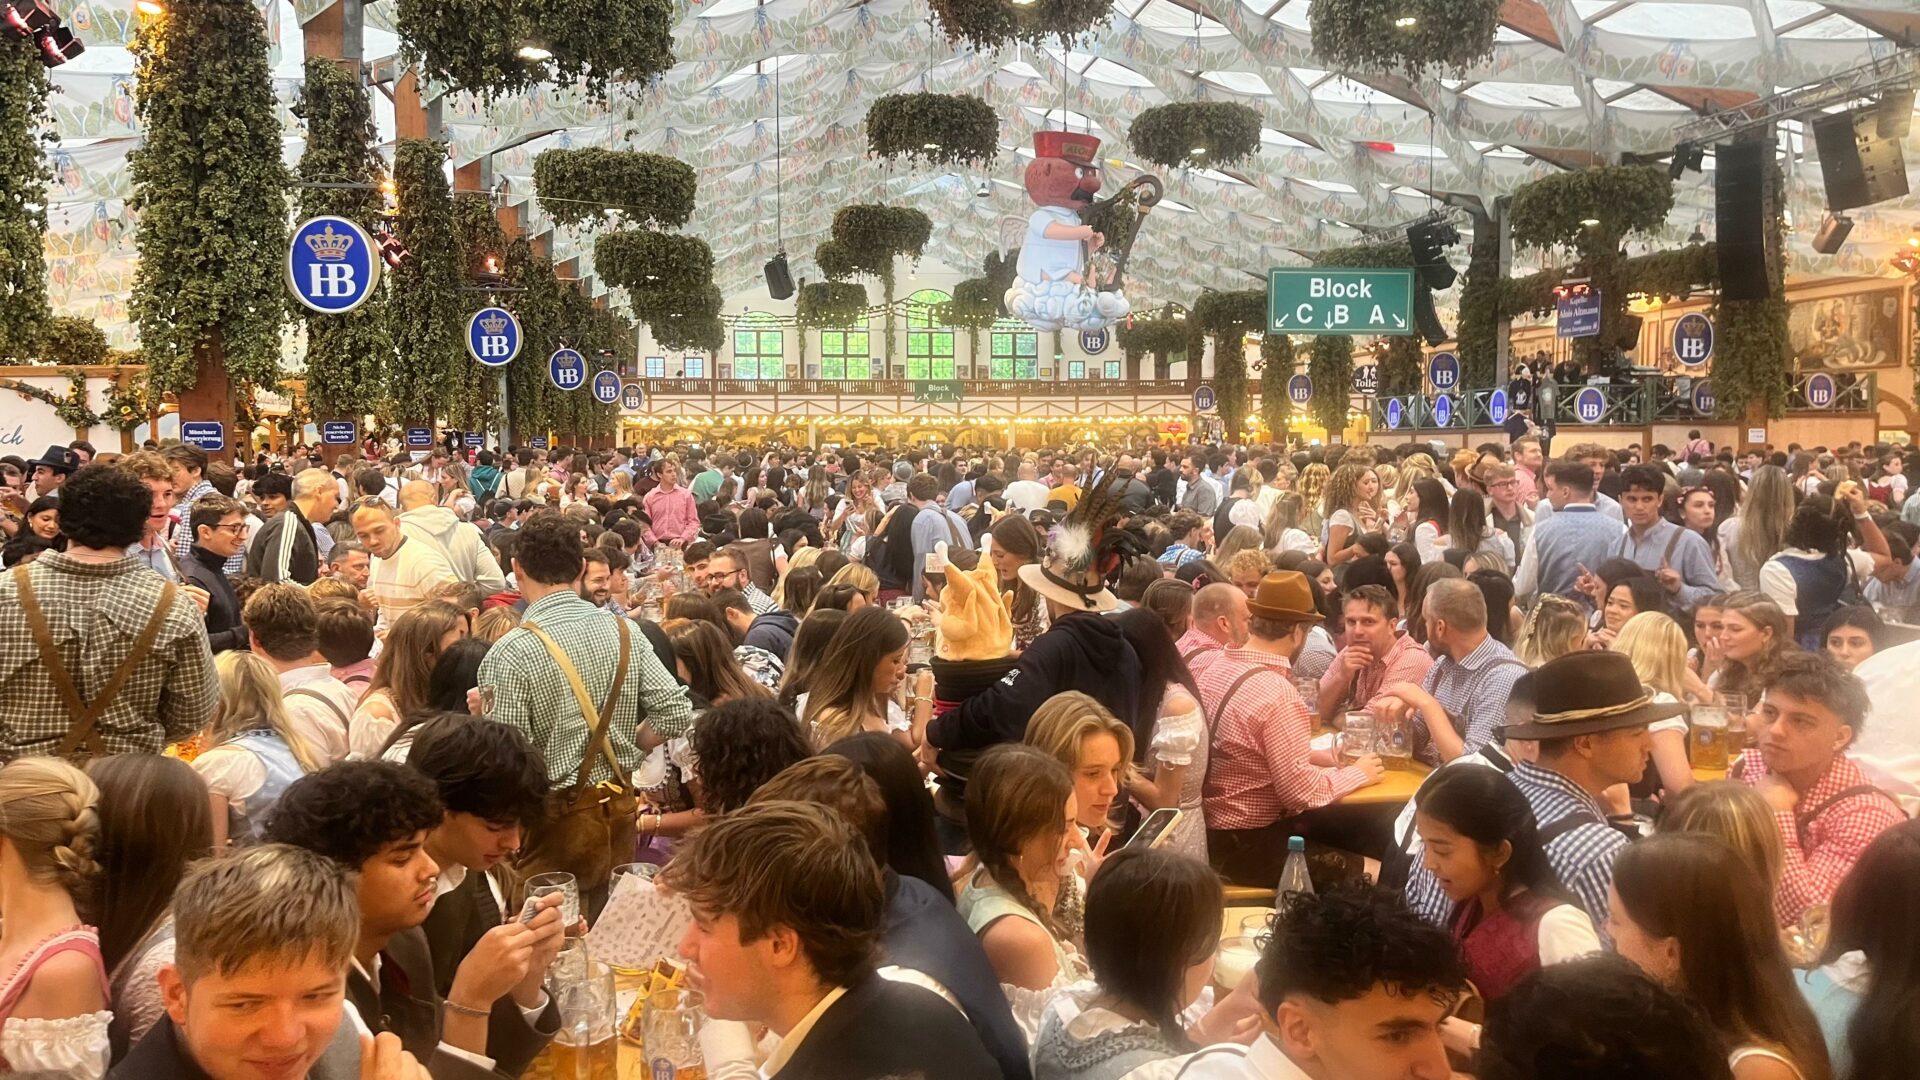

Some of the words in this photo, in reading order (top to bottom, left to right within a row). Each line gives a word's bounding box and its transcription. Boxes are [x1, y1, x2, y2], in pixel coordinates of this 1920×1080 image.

[308, 263, 356, 297] HB
[1310, 277, 1372, 298] Block
[1296, 303, 1313, 324] C
[1334, 304, 1349, 324] B
[1369, 304, 1385, 324] A
[480, 335, 510, 357] HB
[1086, 336, 1101, 349] HB
[1681, 338, 1705, 358] HB
[558, 368, 579, 384] HB
[1436, 370, 1453, 385] HB
[599, 386, 616, 399] HB
[923, 392, 930, 400] K
[1294, 387, 1308, 400] HB
[1813, 389, 1829, 403] HB
[625, 396, 639, 407] HB
[1198, 397, 1211, 408] HB
[1583, 403, 1599, 418] HB
